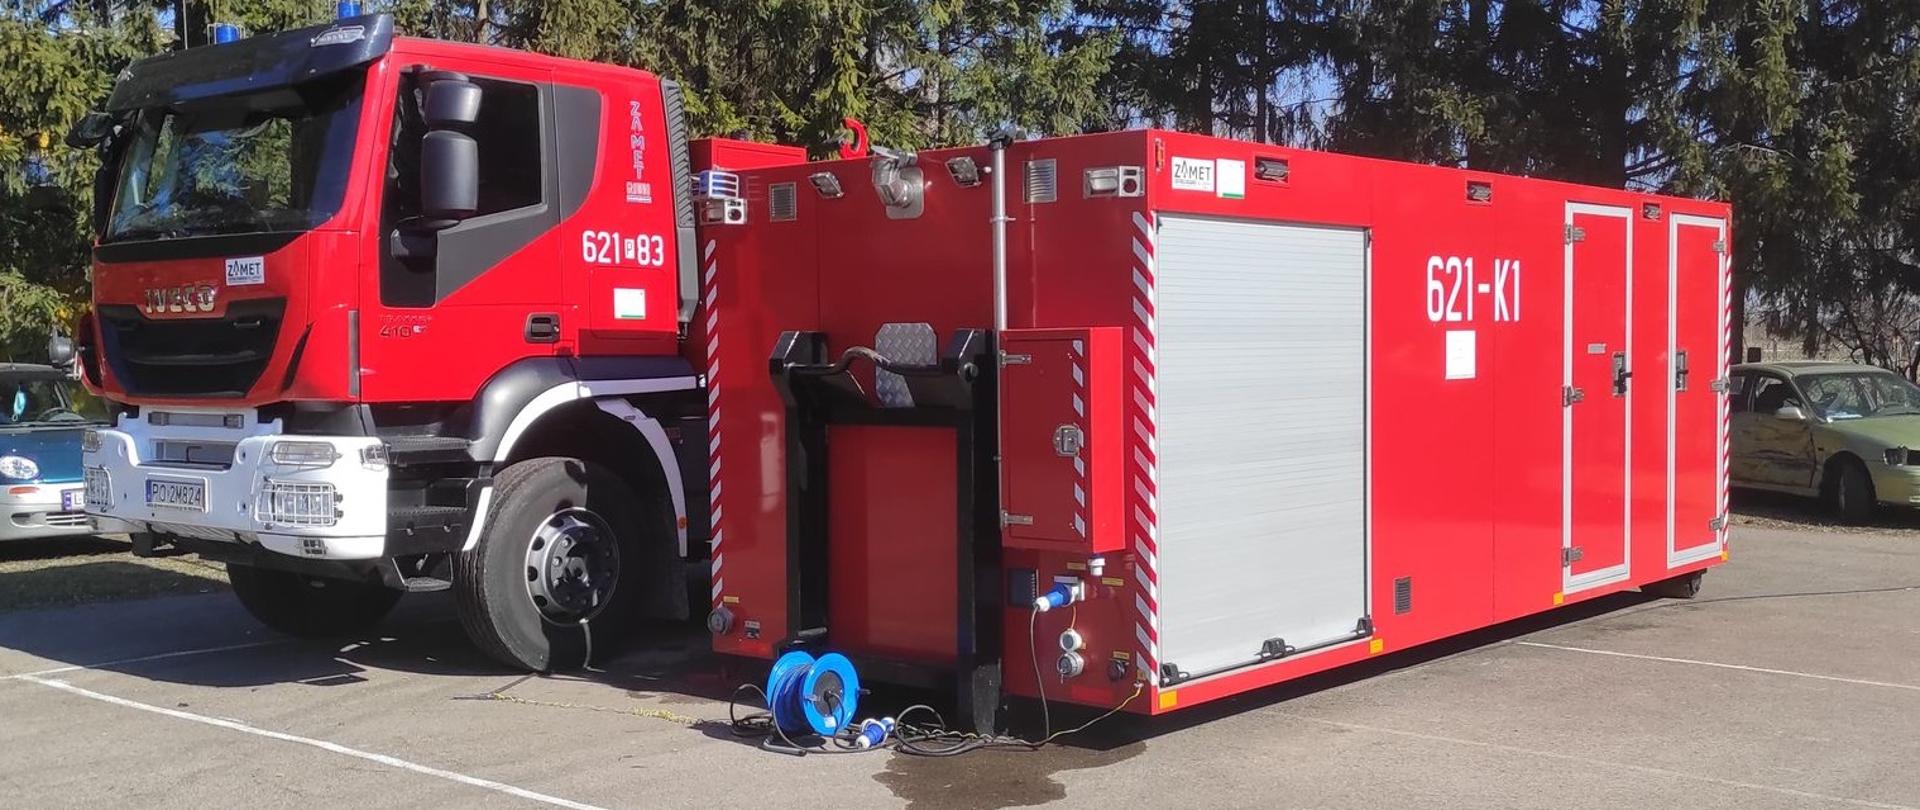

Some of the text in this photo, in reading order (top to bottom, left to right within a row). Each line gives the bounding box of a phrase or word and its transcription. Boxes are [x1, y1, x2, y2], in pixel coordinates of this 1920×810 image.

[629, 100, 645, 180] ZAMET
[1174, 160, 1211, 181] ZAMET
[582, 229, 620, 264] 621
[636, 233, 664, 266] 83
[228, 260, 261, 277] ZAMET
[144, 284, 216, 313] IVECO
[1426, 255, 1520, 322] 621-K1
[152, 483, 166, 502] PO
